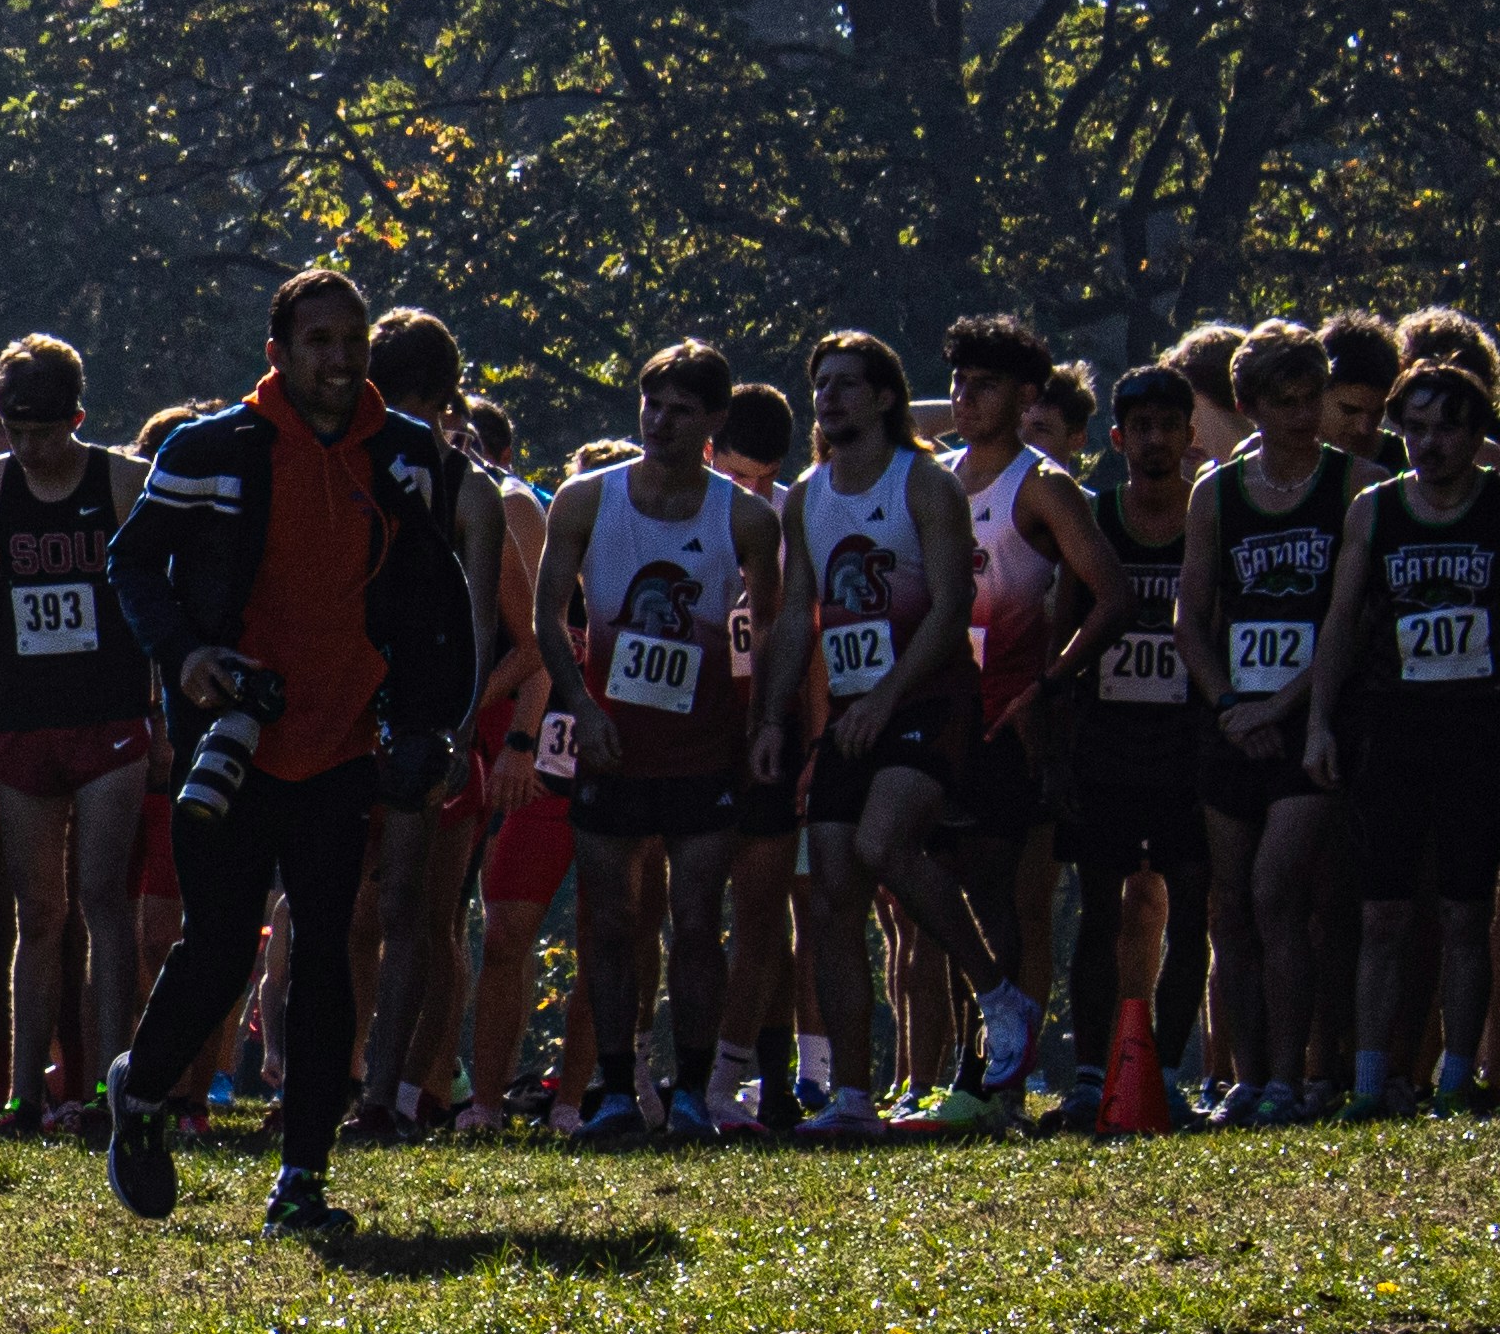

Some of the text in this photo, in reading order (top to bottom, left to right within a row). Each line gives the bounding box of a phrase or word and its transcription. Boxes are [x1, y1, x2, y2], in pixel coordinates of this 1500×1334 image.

[10, 531, 105, 575] SOU
[1237, 538, 1326, 580] GATORS
[1389, 554, 1487, 588] GATORS
[24, 591, 82, 632] 393
[829, 628, 883, 674] 302
[1240, 628, 1300, 668] 202
[1411, 614, 1474, 657] 207
[624, 639, 689, 688] 300
[1113, 639, 1176, 680] 206
